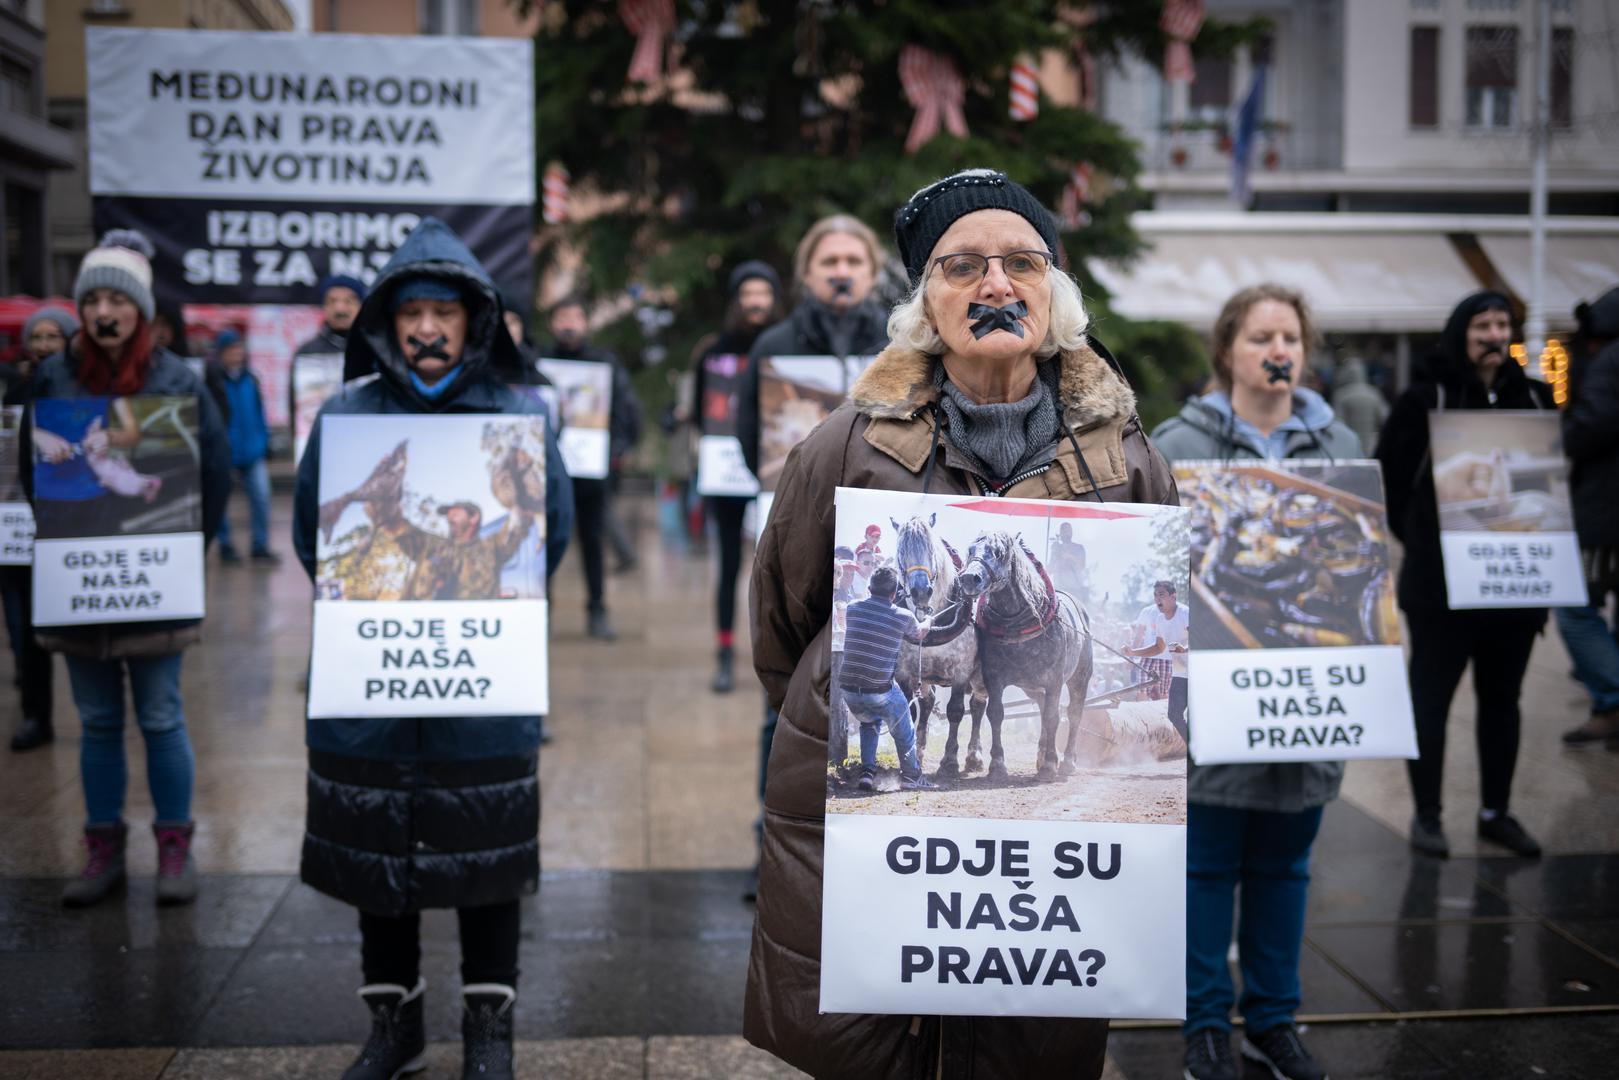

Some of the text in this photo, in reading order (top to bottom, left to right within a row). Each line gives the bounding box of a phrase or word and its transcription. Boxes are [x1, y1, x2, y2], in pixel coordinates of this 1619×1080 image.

[149, 69, 479, 107] MEĐUNARODNI
[188, 111, 441, 145] DAN PRAVA
[201, 143, 430, 184] ŽIVOTINJA
[183, 249, 241, 285] SE
[254, 250, 317, 286] ZA
[63, 548, 169, 570] GDJE SU
[1468, 543, 1553, 560] GDJE SU
[81, 568, 149, 589] NAŠA
[1485, 560, 1541, 576] NAŠA
[1479, 581, 1553, 597] PRAVA?
[71, 592, 162, 612] PRAVA?
[357, 618, 502, 639] GDJE SU
[381, 642, 476, 669] NAŠA
[365, 677, 491, 700] PRAVA?
[1232, 665, 1366, 690] GDJE SU
[1258, 690, 1348, 717] NAŠA
[1247, 724, 1364, 749] PRAVA?
[886, 836, 1121, 880] GDJE SU
[926, 880, 1081, 932] NAŠA
[901, 945, 1106, 987] PRAVA?
